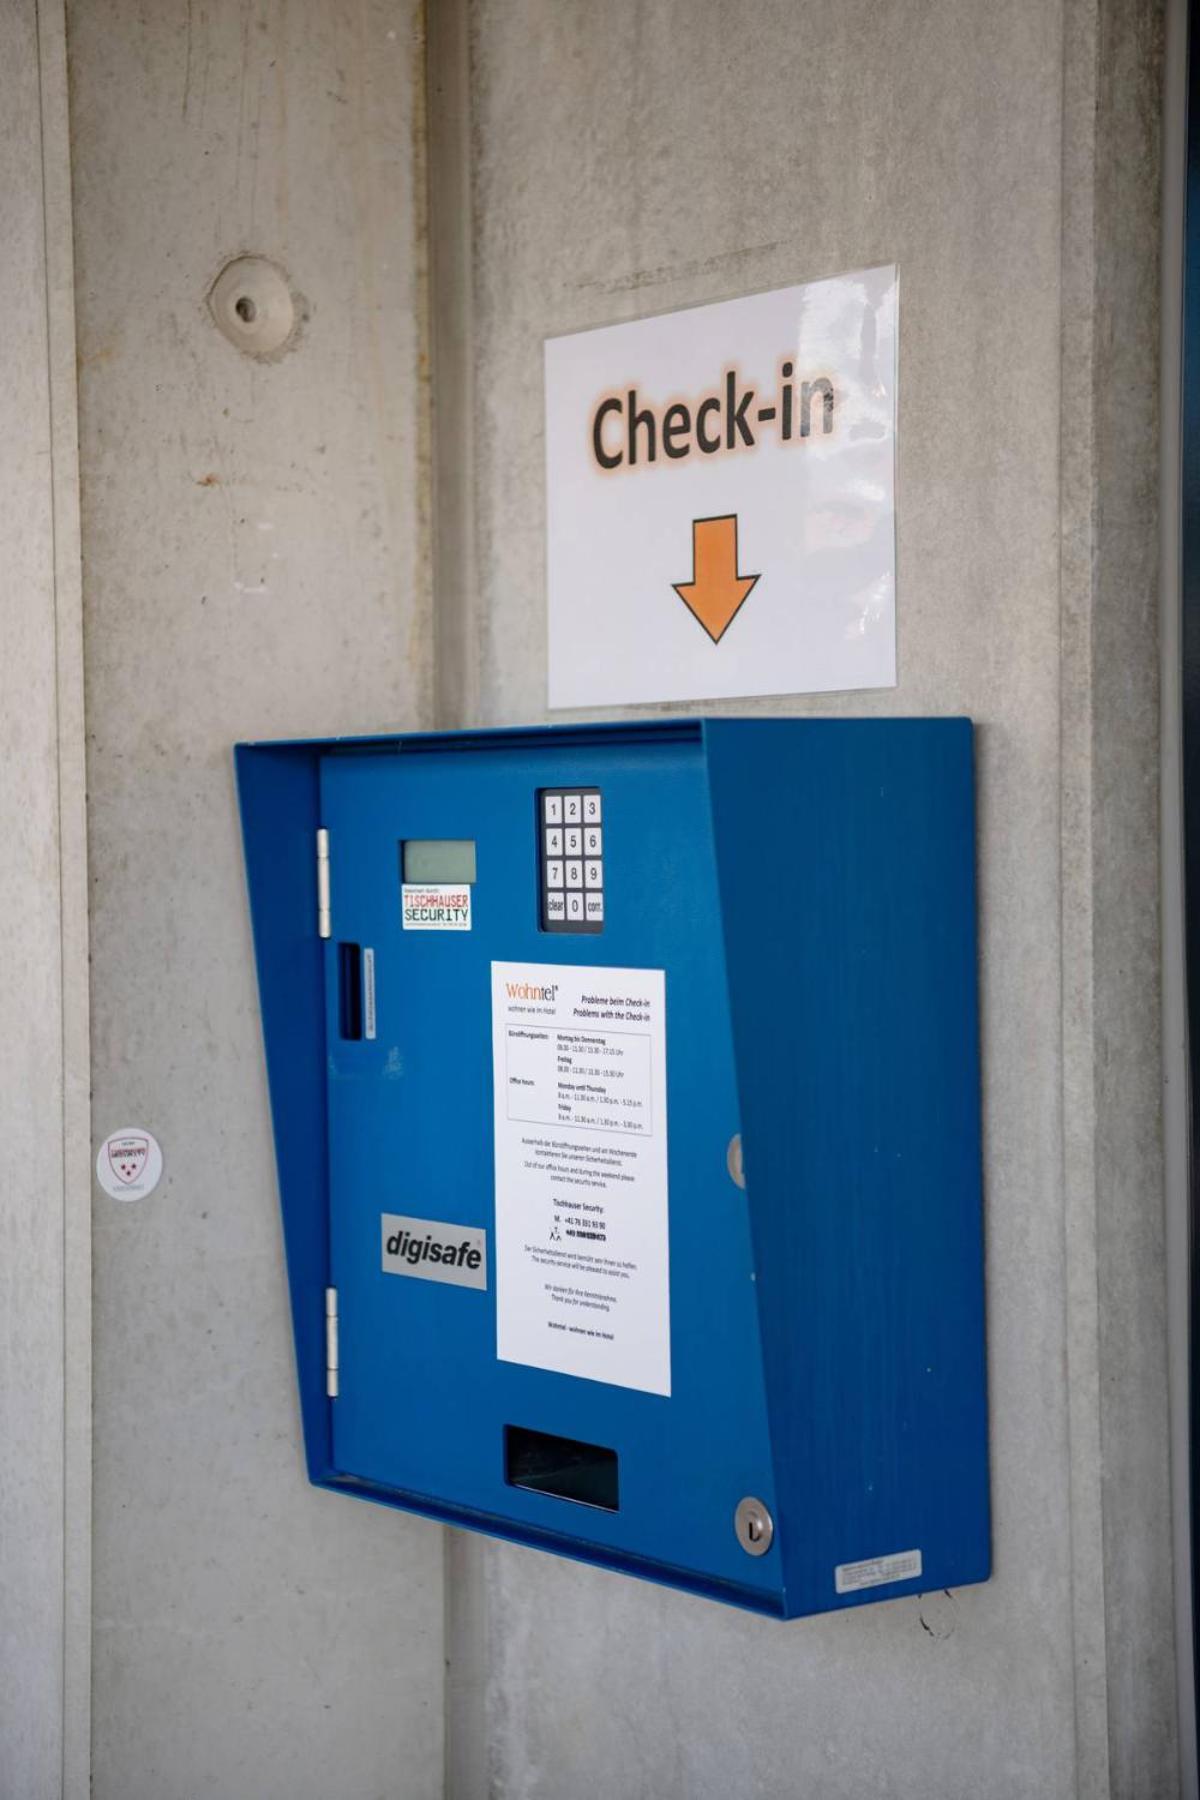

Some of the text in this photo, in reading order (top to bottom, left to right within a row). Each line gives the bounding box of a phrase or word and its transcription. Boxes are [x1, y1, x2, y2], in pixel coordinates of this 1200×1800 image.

[592, 362, 834, 469] Check-in
[552, 802, 596, 816] 1 2 3
[552, 835, 597, 847] 4 5 6
[553, 867, 597, 880] 7 8 9
[404, 895, 468, 908] TISCHHAUSER
[572, 900, 578, 912] 0
[404, 908, 468, 921] SECURITY
[582, 996, 650, 1008] Probleme beim Check-in
[573, 1009, 650, 1022] Problems with the Check-in
[386, 1230, 482, 1269] digisafe
